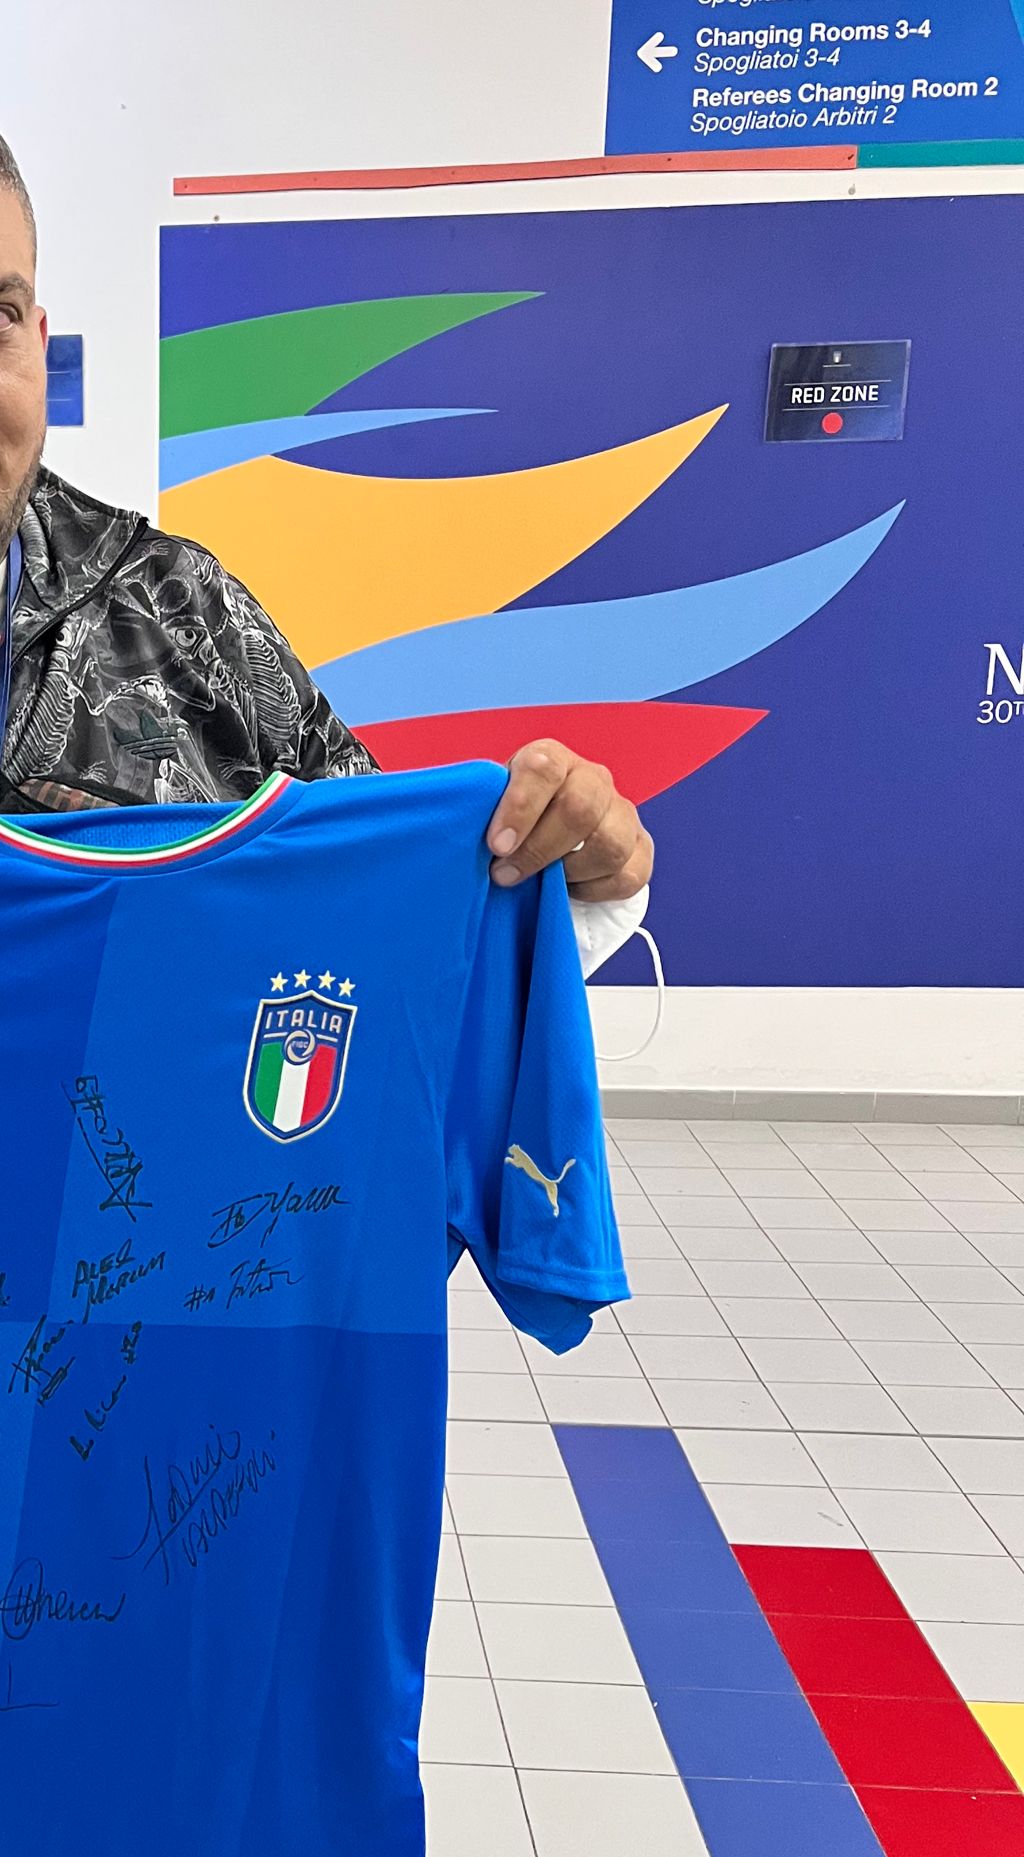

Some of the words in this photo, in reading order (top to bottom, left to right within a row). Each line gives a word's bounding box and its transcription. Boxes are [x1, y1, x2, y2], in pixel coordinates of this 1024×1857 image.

[696, 25, 803, 49] Changing
[809, 22, 889, 42] Rooms
[895, 20, 932, 39] 3-4
[693, 49, 800, 76] Spogliatoi
[804, 47, 841, 68] 3-4
[692, 87, 792, 108] Referees
[798, 81, 905, 105] Changing
[911, 79, 977, 99] Room
[984, 77, 999, 97] 2
[690, 109, 808, 136] Spogliatoio
[812, 105, 878, 127] Arbitri
[882, 105, 898, 125] 2
[791, 386, 825, 404] RED
[830, 385, 879, 403] ZONE
[976, 699, 1024, 724] 30T
[265, 1009, 343, 1034] ITALIA
